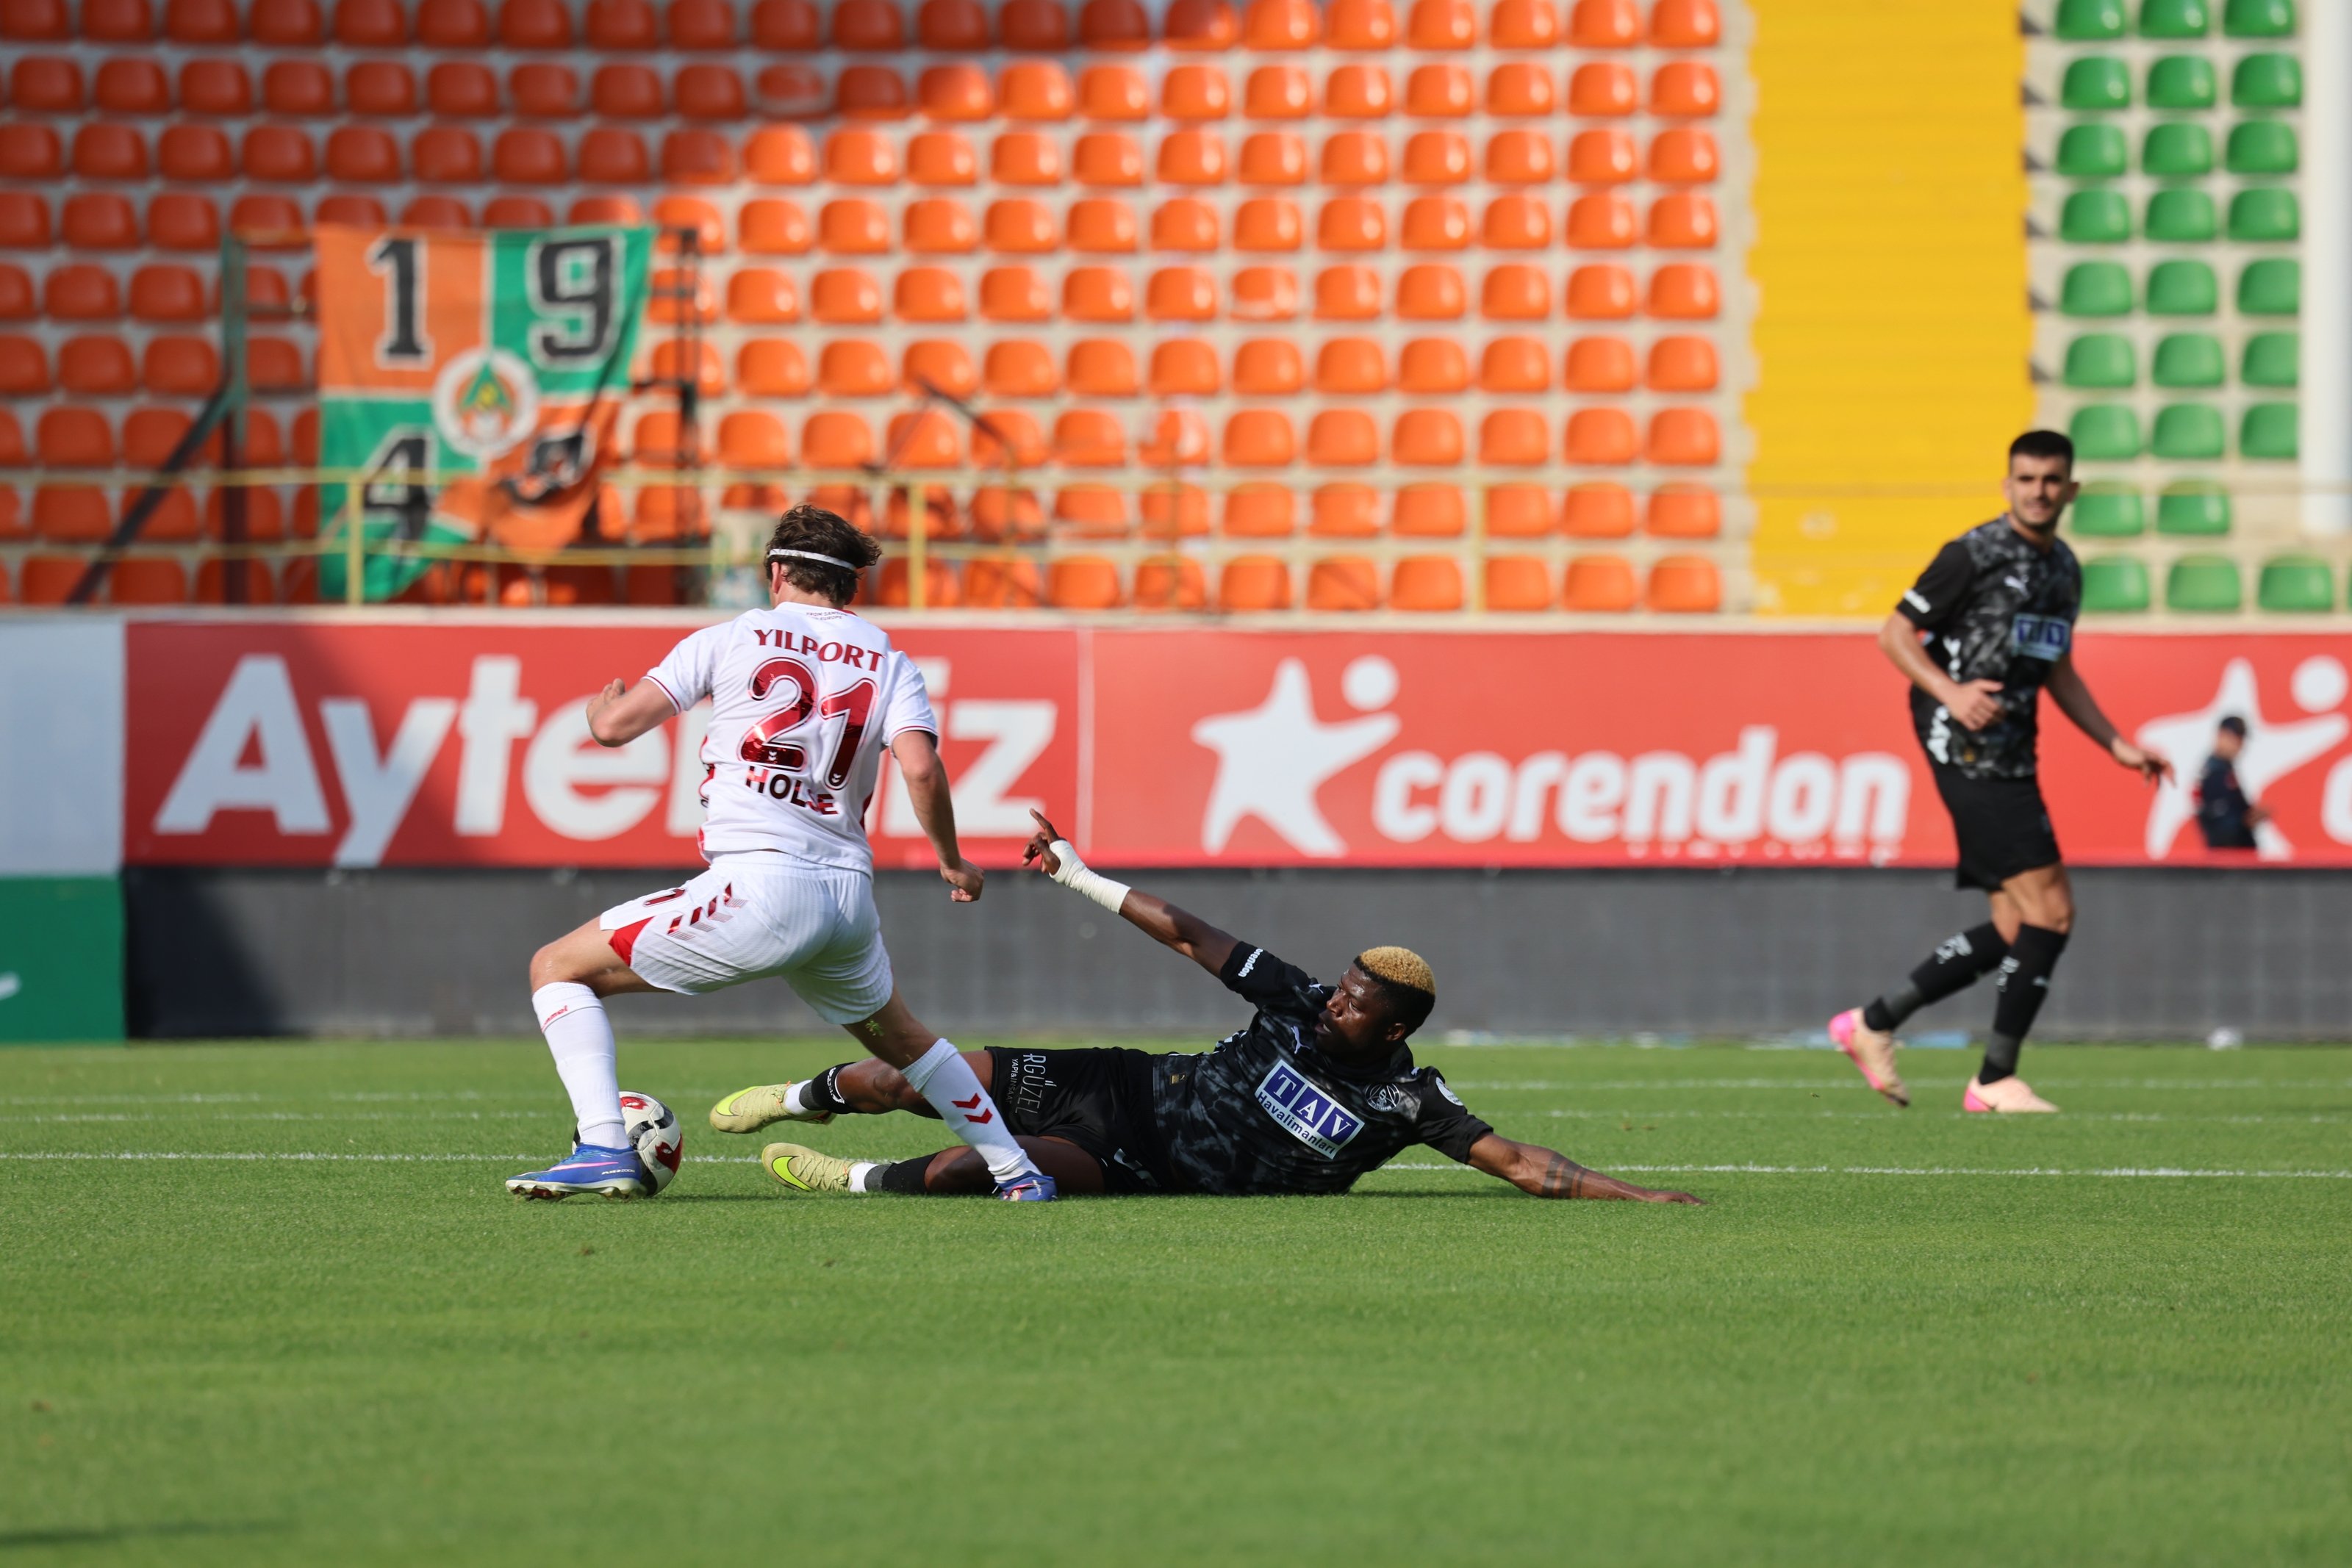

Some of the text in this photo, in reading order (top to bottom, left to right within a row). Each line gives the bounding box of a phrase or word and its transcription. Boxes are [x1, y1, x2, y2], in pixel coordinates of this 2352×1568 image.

[369, 235, 617, 362] 1 9
[754, 629, 886, 672] YILPORT
[737, 656, 878, 791] 21
[1372, 723, 1911, 843] corendon
[1238, 948, 1263, 978] orendon
[1014, 1053, 1057, 1114] RGÜZEL
[1273, 1073, 1352, 1138] TAV
